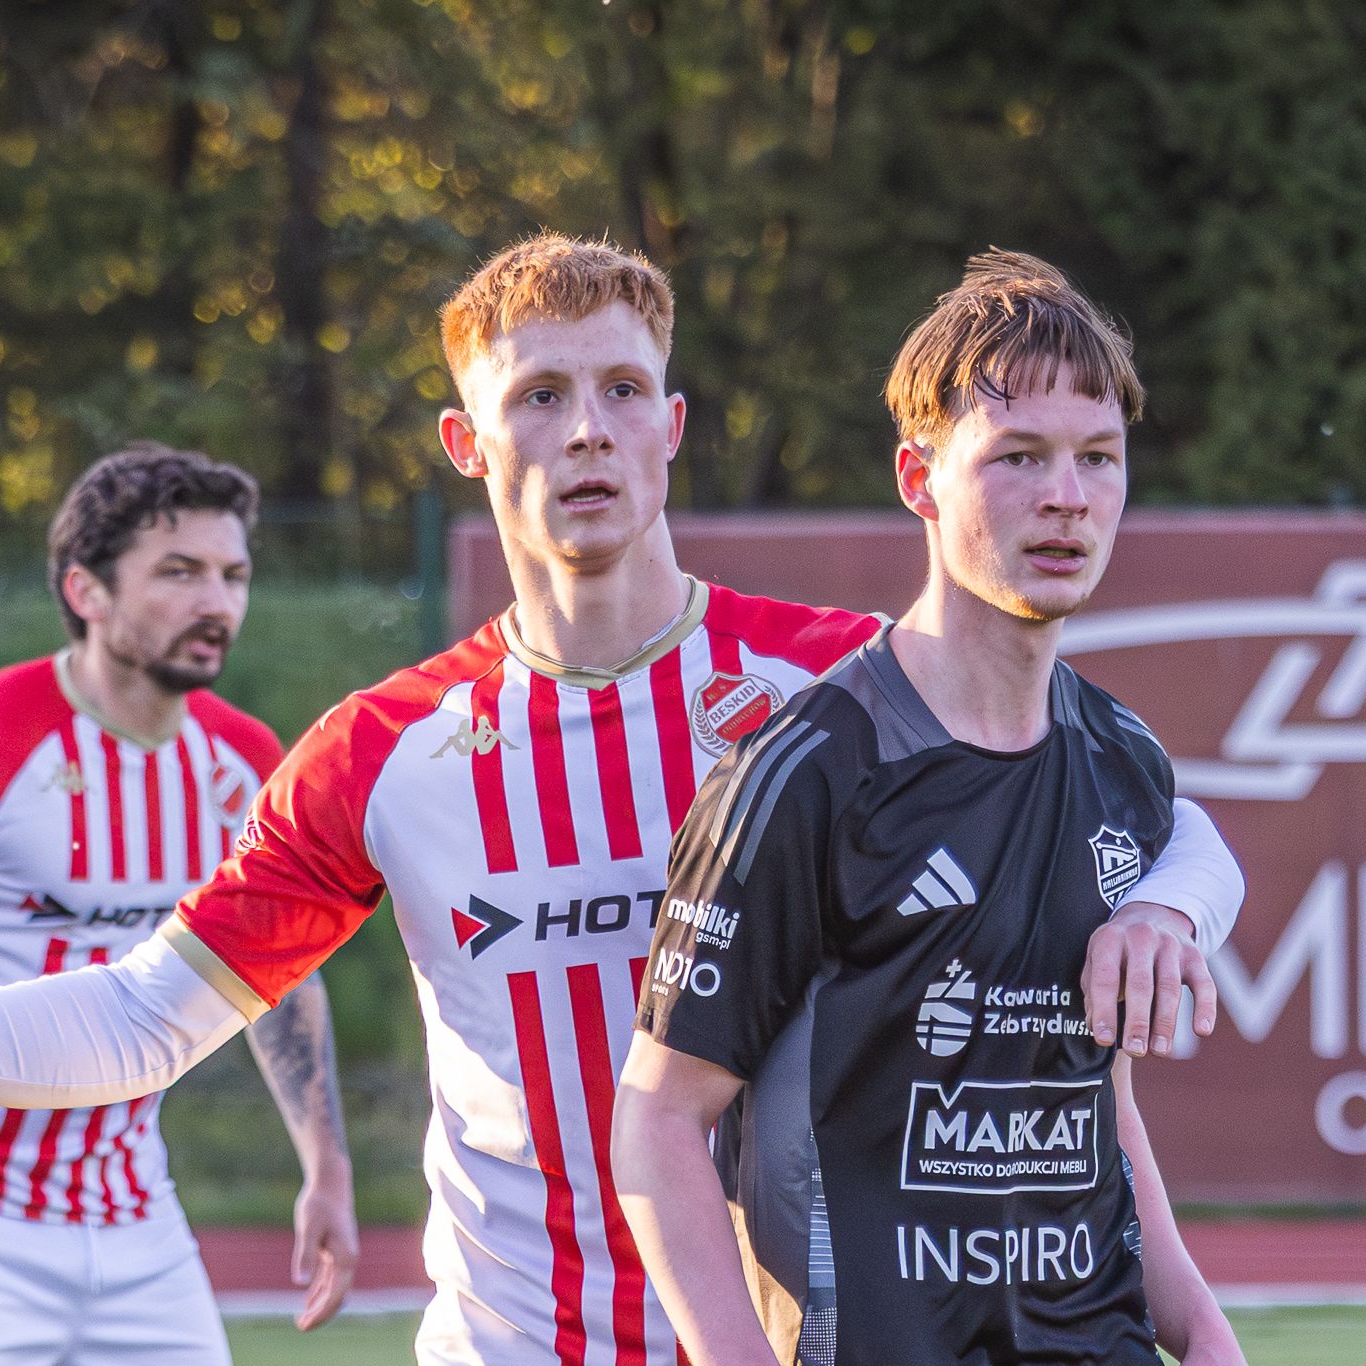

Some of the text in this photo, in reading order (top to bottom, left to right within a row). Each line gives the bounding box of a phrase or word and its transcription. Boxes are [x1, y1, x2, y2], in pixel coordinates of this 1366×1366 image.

[709, 684, 756, 724] BESKID
[667, 898, 740, 940] mobilki
[924, 1109, 1092, 1153] MARKAT
[919, 1160, 993, 1177] WSZYSTKO
[897, 1223, 1094, 1285] INSPIRO
